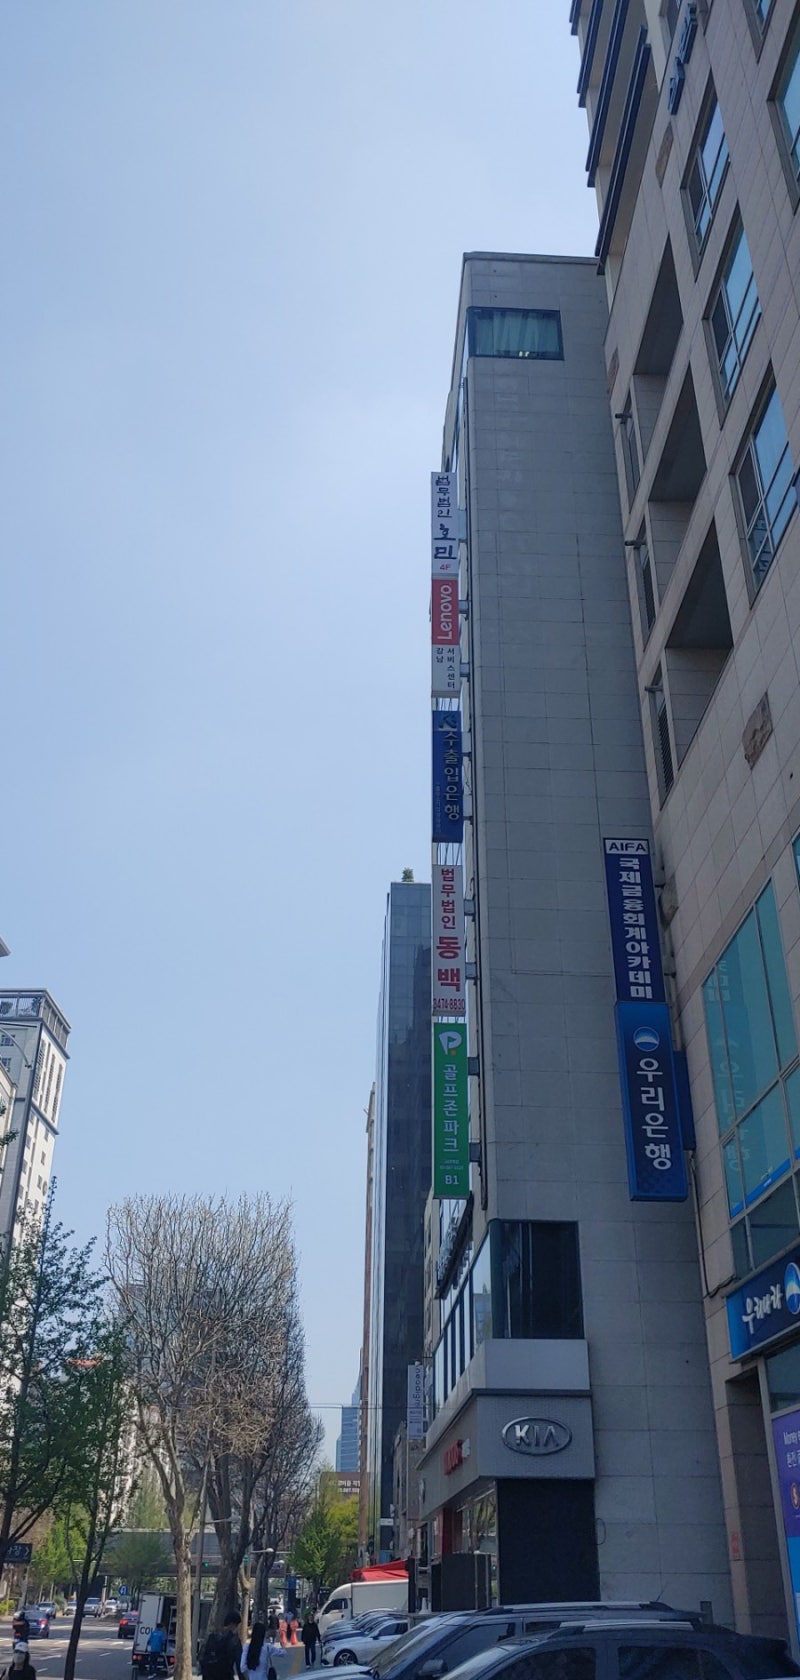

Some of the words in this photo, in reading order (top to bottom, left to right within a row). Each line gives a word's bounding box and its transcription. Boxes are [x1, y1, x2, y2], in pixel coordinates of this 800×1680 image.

[436, 475, 453, 518] 법무법인
[440, 563, 451, 571] 4F
[437, 585, 453, 640] Lenovo
[447, 647, 456, 689] 서비스센터
[444, 731, 460, 821] 수출입은행
[608, 841, 647, 852] AIFA
[441, 868, 456, 930] 법무법인
[618, 857, 653, 999] 국제금융회계아카데미
[436, 935, 461, 992] 동백
[443, 1064, 459, 1152] 골프존파크
[636, 1057, 672, 1170] 우리은행
[445, 1174, 460, 1185] B1
[514, 1424, 560, 1447] KIA
